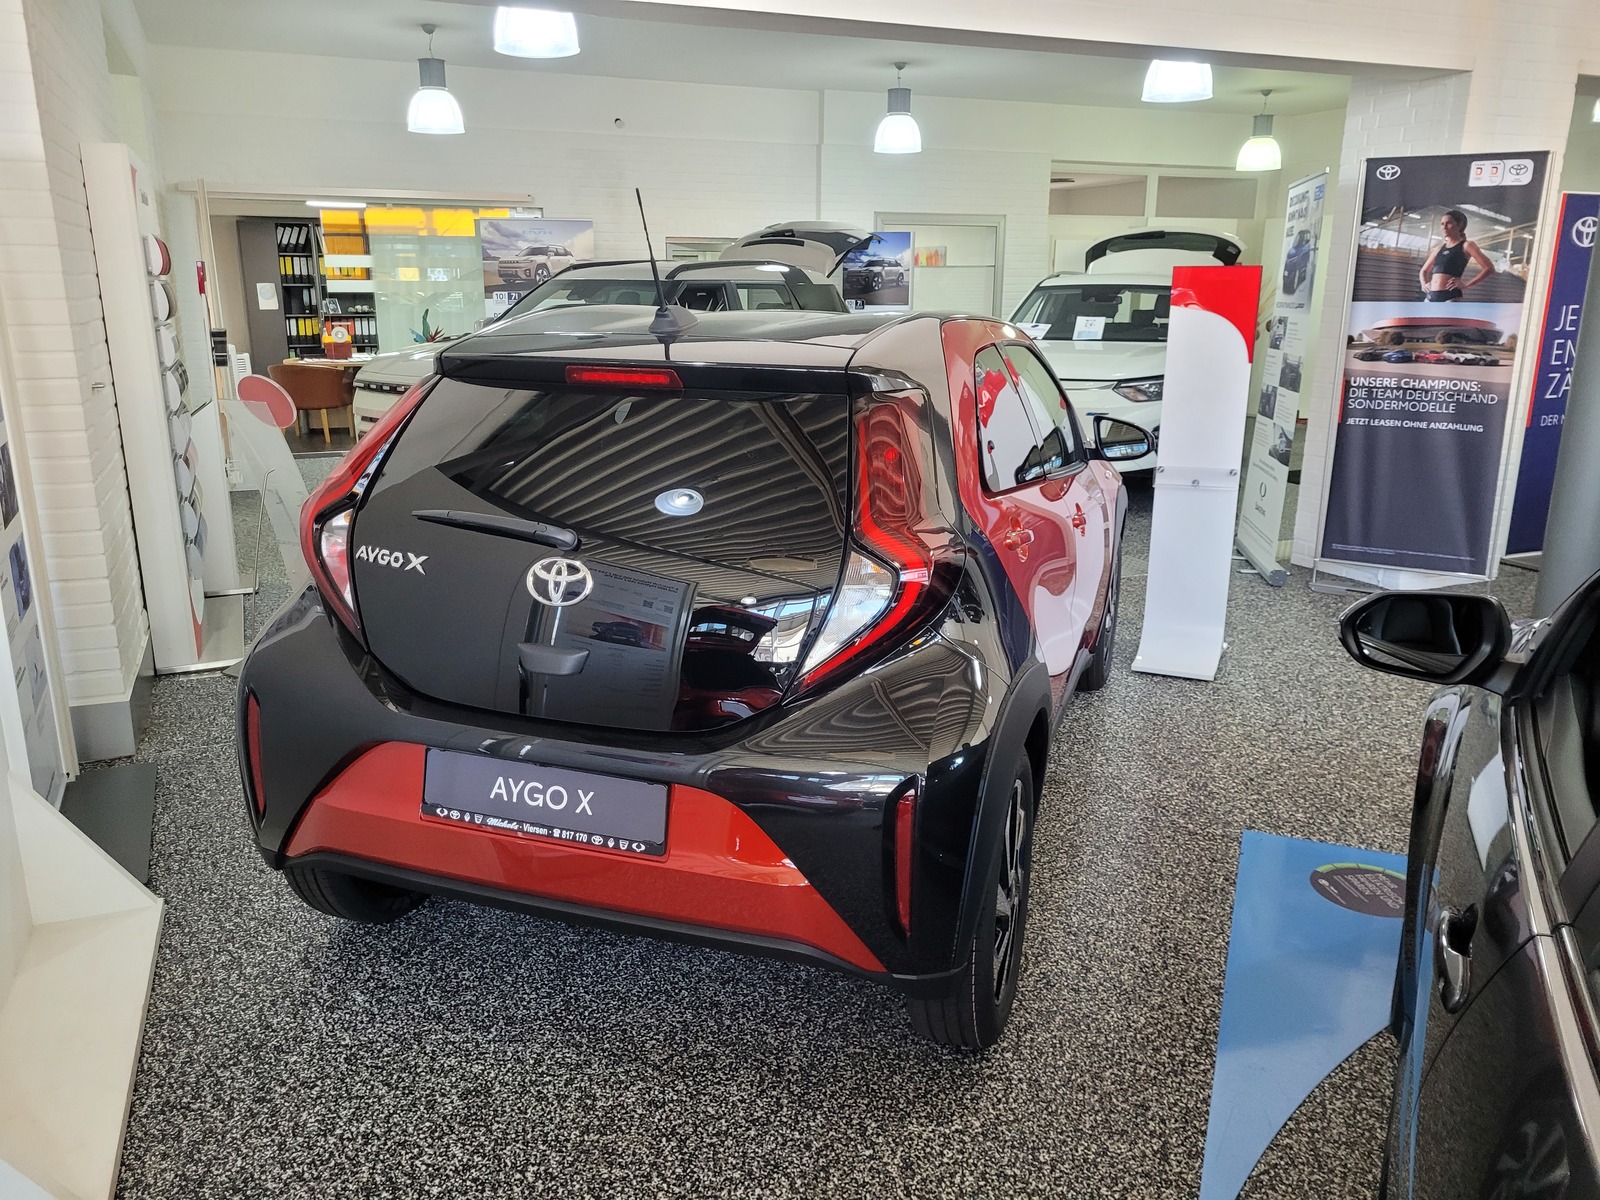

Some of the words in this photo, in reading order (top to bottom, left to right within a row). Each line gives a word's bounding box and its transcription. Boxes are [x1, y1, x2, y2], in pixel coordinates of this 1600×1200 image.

[1554, 304, 1580, 331] JE
[1350, 376, 1398, 388] UNSERE
[1400, 378, 1481, 392] CHAMPIONS:
[1350, 388, 1368, 398] DIE
[1372, 389, 1402, 400] TEAM
[1406, 390, 1498, 404] DEUTSCHLAND
[1348, 399, 1456, 414] SONDERMODELLE
[1346, 418, 1369, 426] JETZT
[1370, 418, 1401, 427] LEASEN
[1402, 420, 1428, 429] OHNE
[1428, 422, 1484, 432] ANZAHLUNG
[1540, 414, 1558, 426] DER
[356, 544, 404, 568] AYGO
[404, 552, 429, 576] X
[490, 776, 568, 810] AYGO
[575, 790, 594, 816] X
[486, 818, 520, 830] Michels
[524, 823, 548, 835] Viersen
[562, 830, 573, 840] 817
[576, 832, 588, 842] 170
